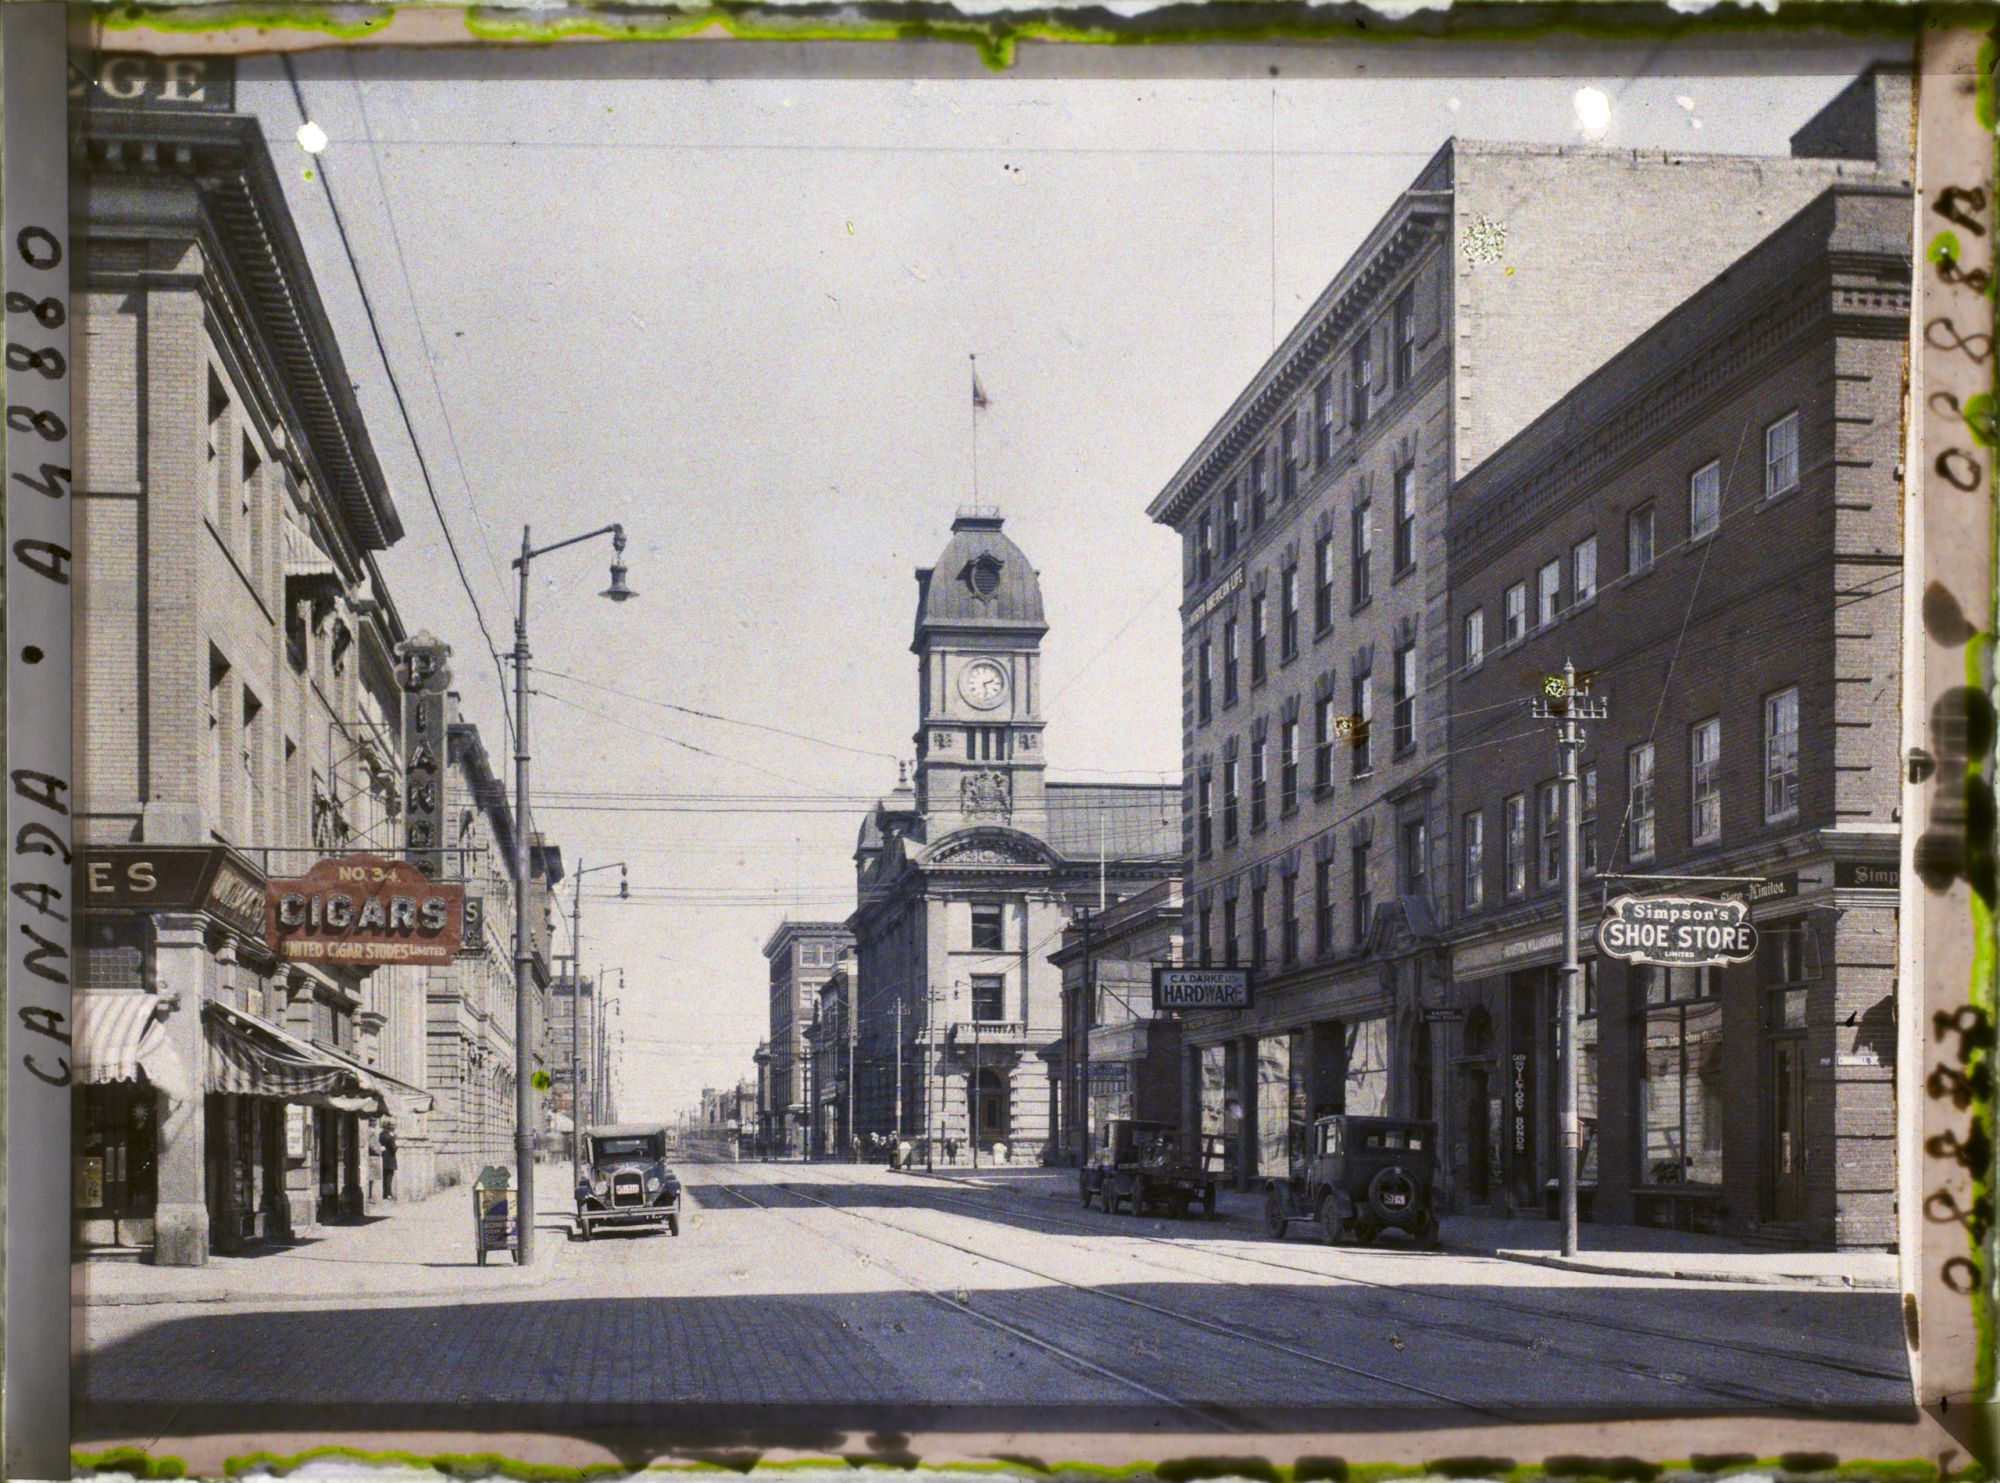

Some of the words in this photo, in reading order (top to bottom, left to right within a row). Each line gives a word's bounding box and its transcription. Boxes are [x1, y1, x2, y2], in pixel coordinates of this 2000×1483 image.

[69, 57, 206, 101] GE
[279, 892, 448, 930] CIGARS
[1633, 904, 1729, 923] Simpson's
[11, 769, 72, 1088] CANADA
[1609, 923, 1669, 948] SHOE
[1678, 926, 1750, 950] STORE
[281, 941, 324, 957] UNITED
[327, 942, 363, 958] CIGAR
[366, 942, 409, 959] STORES
[409, 944, 447, 956] LIMITED
[1664, 950, 1695, 959] LIMITED
[1164, 984, 1243, 1002] HARDWARE
[1515, 1065, 1525, 1112] VICTORY
[1516, 1116, 1525, 1152] BONDS
